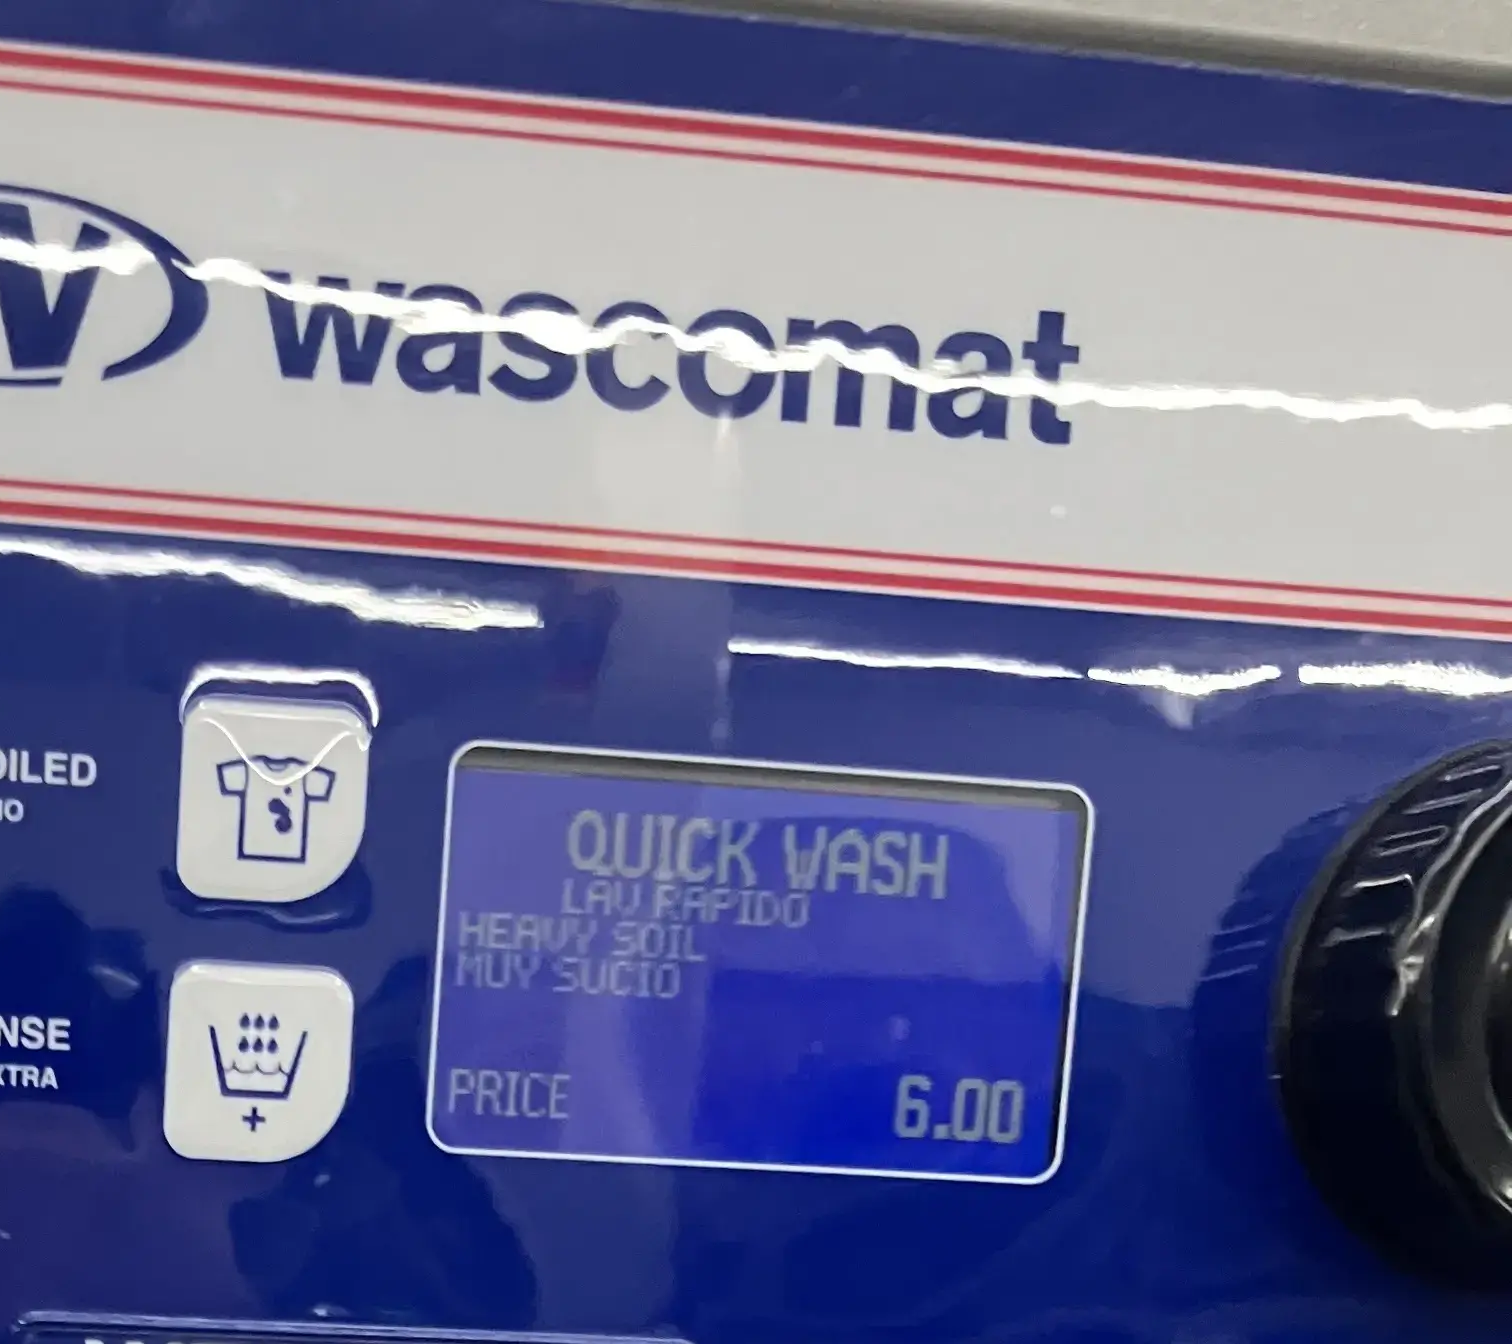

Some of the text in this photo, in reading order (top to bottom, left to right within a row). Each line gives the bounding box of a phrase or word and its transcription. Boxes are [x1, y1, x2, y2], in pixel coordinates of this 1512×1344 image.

[263, 271, 1079, 445] wascomat
[567, 809, 949, 900] QUICK WASH
[561, 878, 641, 915] LAV
[459, 911, 707, 961] HEAVY SOIL
[454, 953, 680, 998] MUY SUCIO
[448, 1068, 571, 1118] PRICE
[894, 1074, 1025, 1143] 6.00
